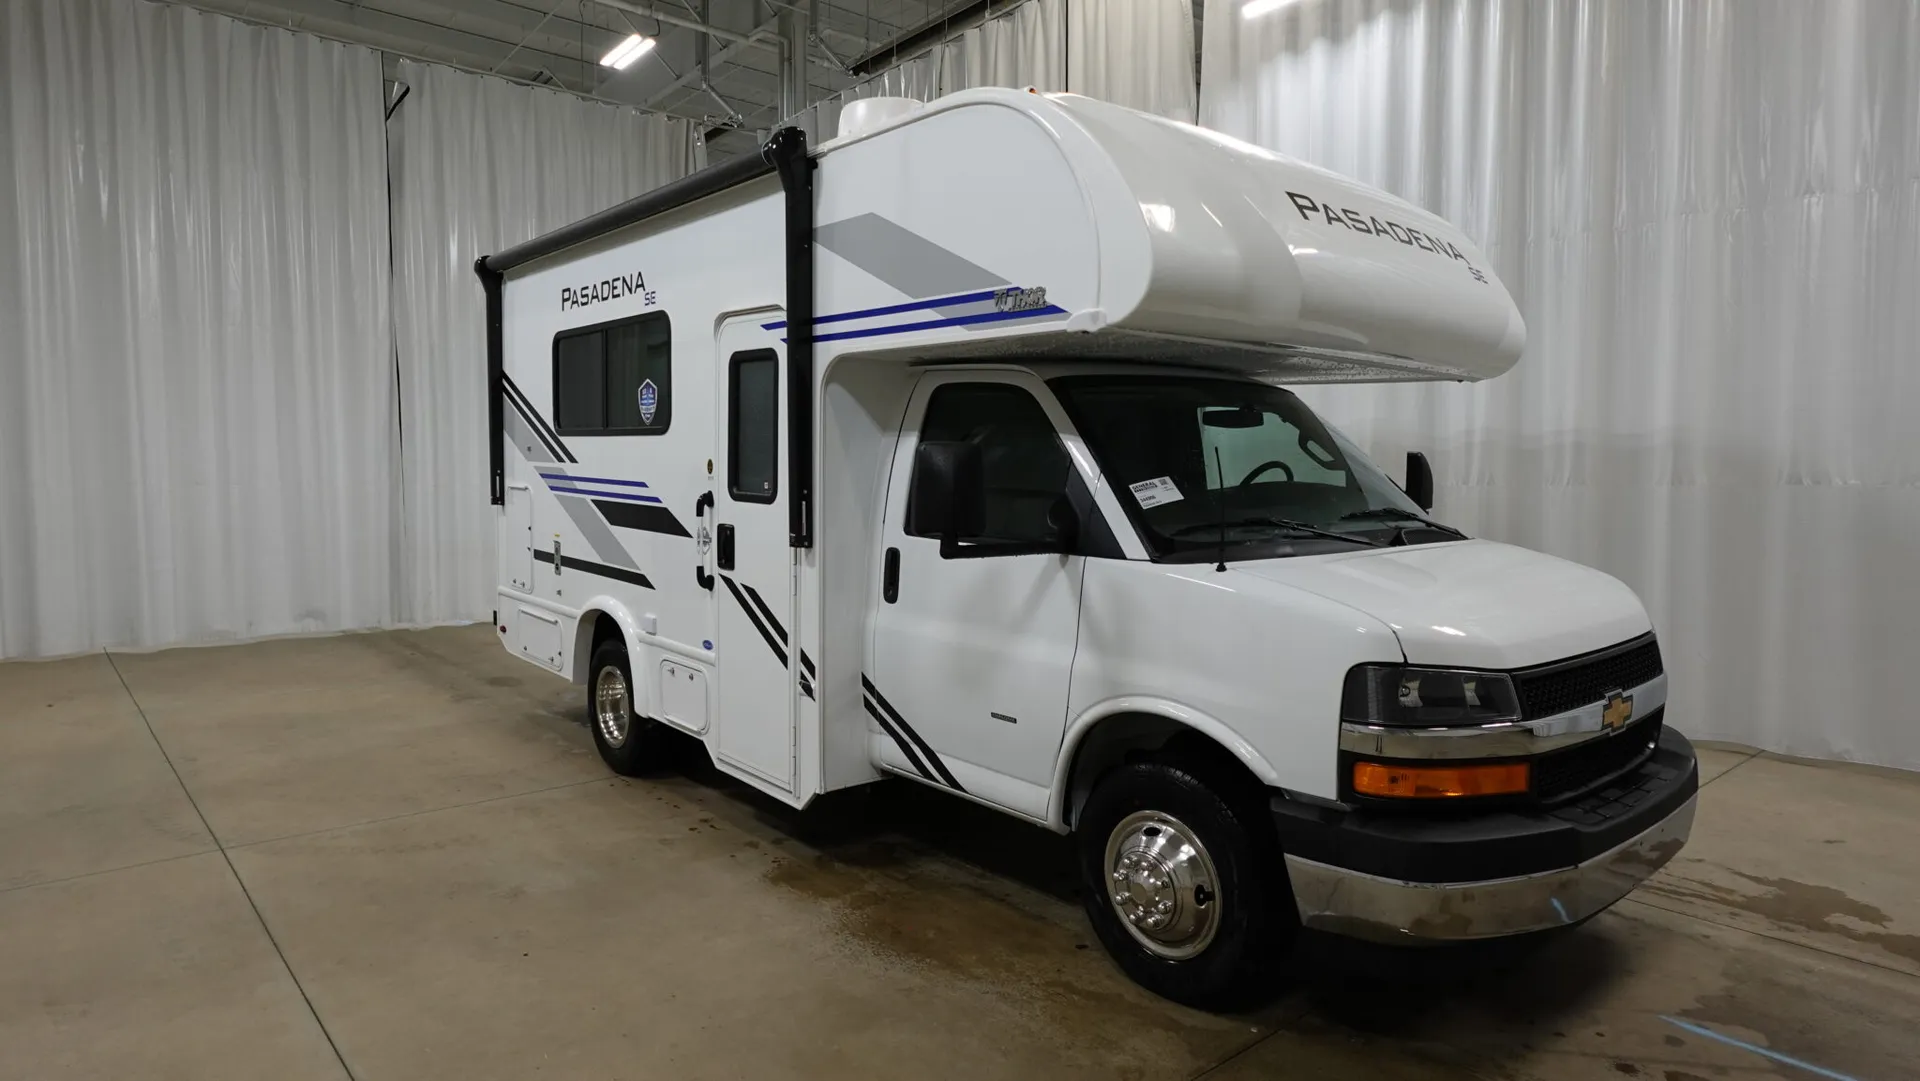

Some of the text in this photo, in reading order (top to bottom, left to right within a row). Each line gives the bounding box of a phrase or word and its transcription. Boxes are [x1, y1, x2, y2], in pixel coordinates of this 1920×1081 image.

[1285, 191, 1471, 265] PASADENA
[561, 271, 646, 312] PASADENA
[644, 291, 656, 306] SE
